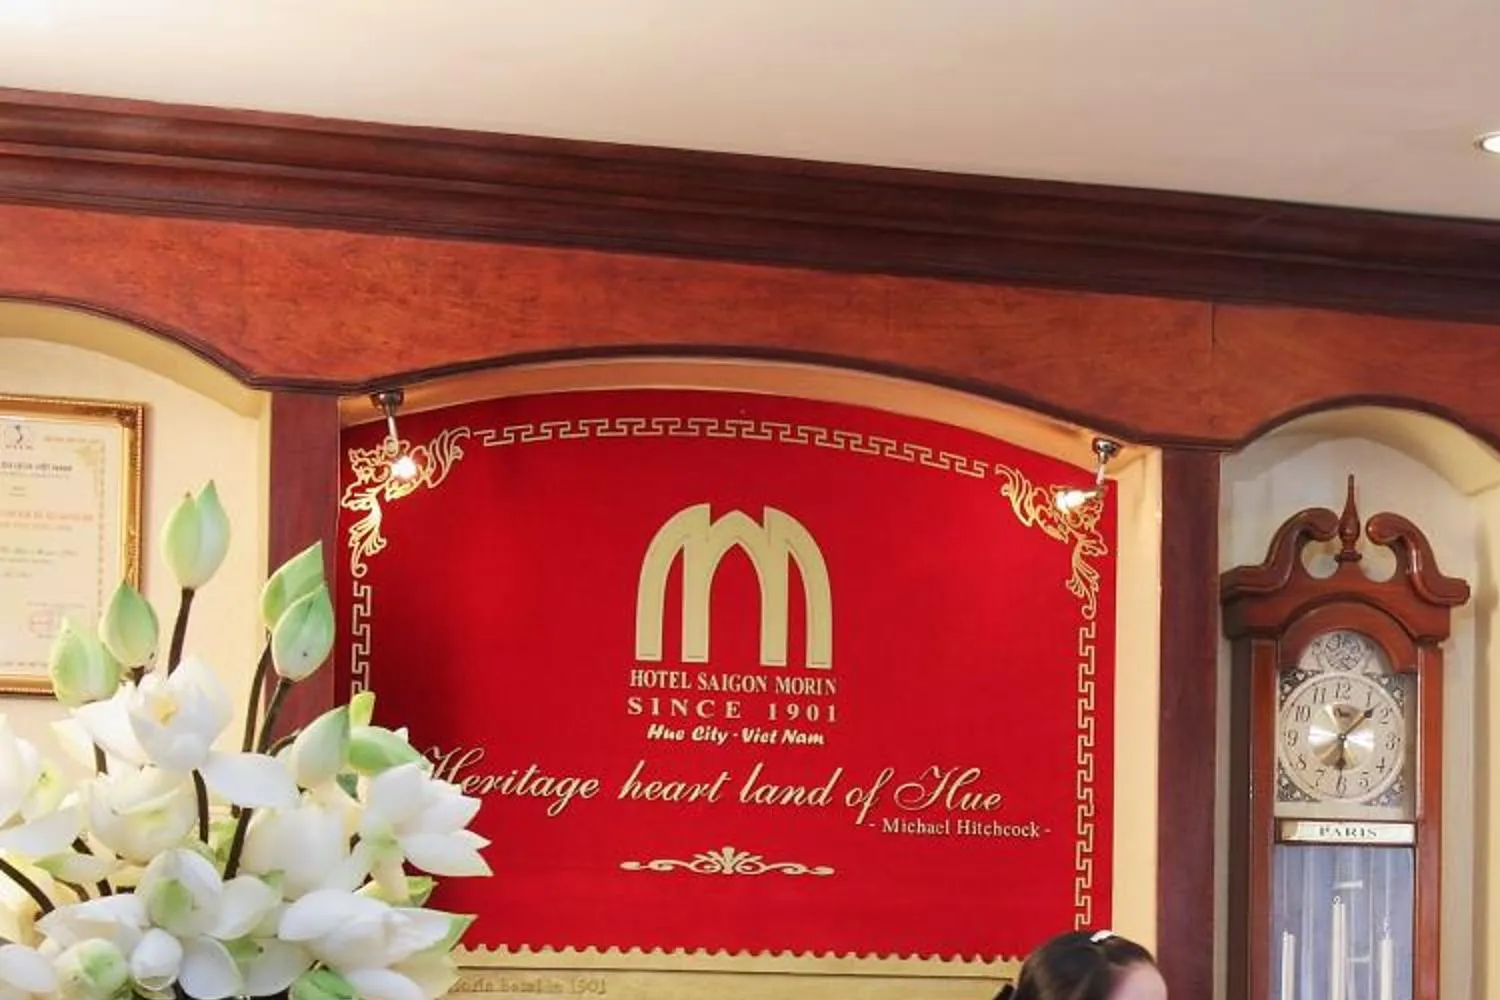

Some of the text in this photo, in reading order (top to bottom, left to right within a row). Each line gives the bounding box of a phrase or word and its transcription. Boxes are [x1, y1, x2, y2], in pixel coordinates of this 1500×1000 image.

[629, 669, 837, 696] HOTEL SAIGON MORIN
[1335, 683, 1351, 700] 12
[1312, 687, 1326, 704] 11
[627, 697, 837, 723] SINCE 1901
[1295, 705, 1311, 722] 10
[647, 723, 685, 741] Hue
[691, 725, 728, 744] City
[741, 727, 777, 744] Viet
[781, 729, 824, 745] Nam
[1386, 734, 1395, 750] 3
[1376, 757, 1386, 772] 4
[425, 746, 1002, 825] Heritage heart land of Hue
[1315, 768, 1325, 788] 7
[882, 817, 950, 835] Michael
[957, 819, 1041, 838] Hitchcock
[1319, 826, 1378, 838] PARIS
